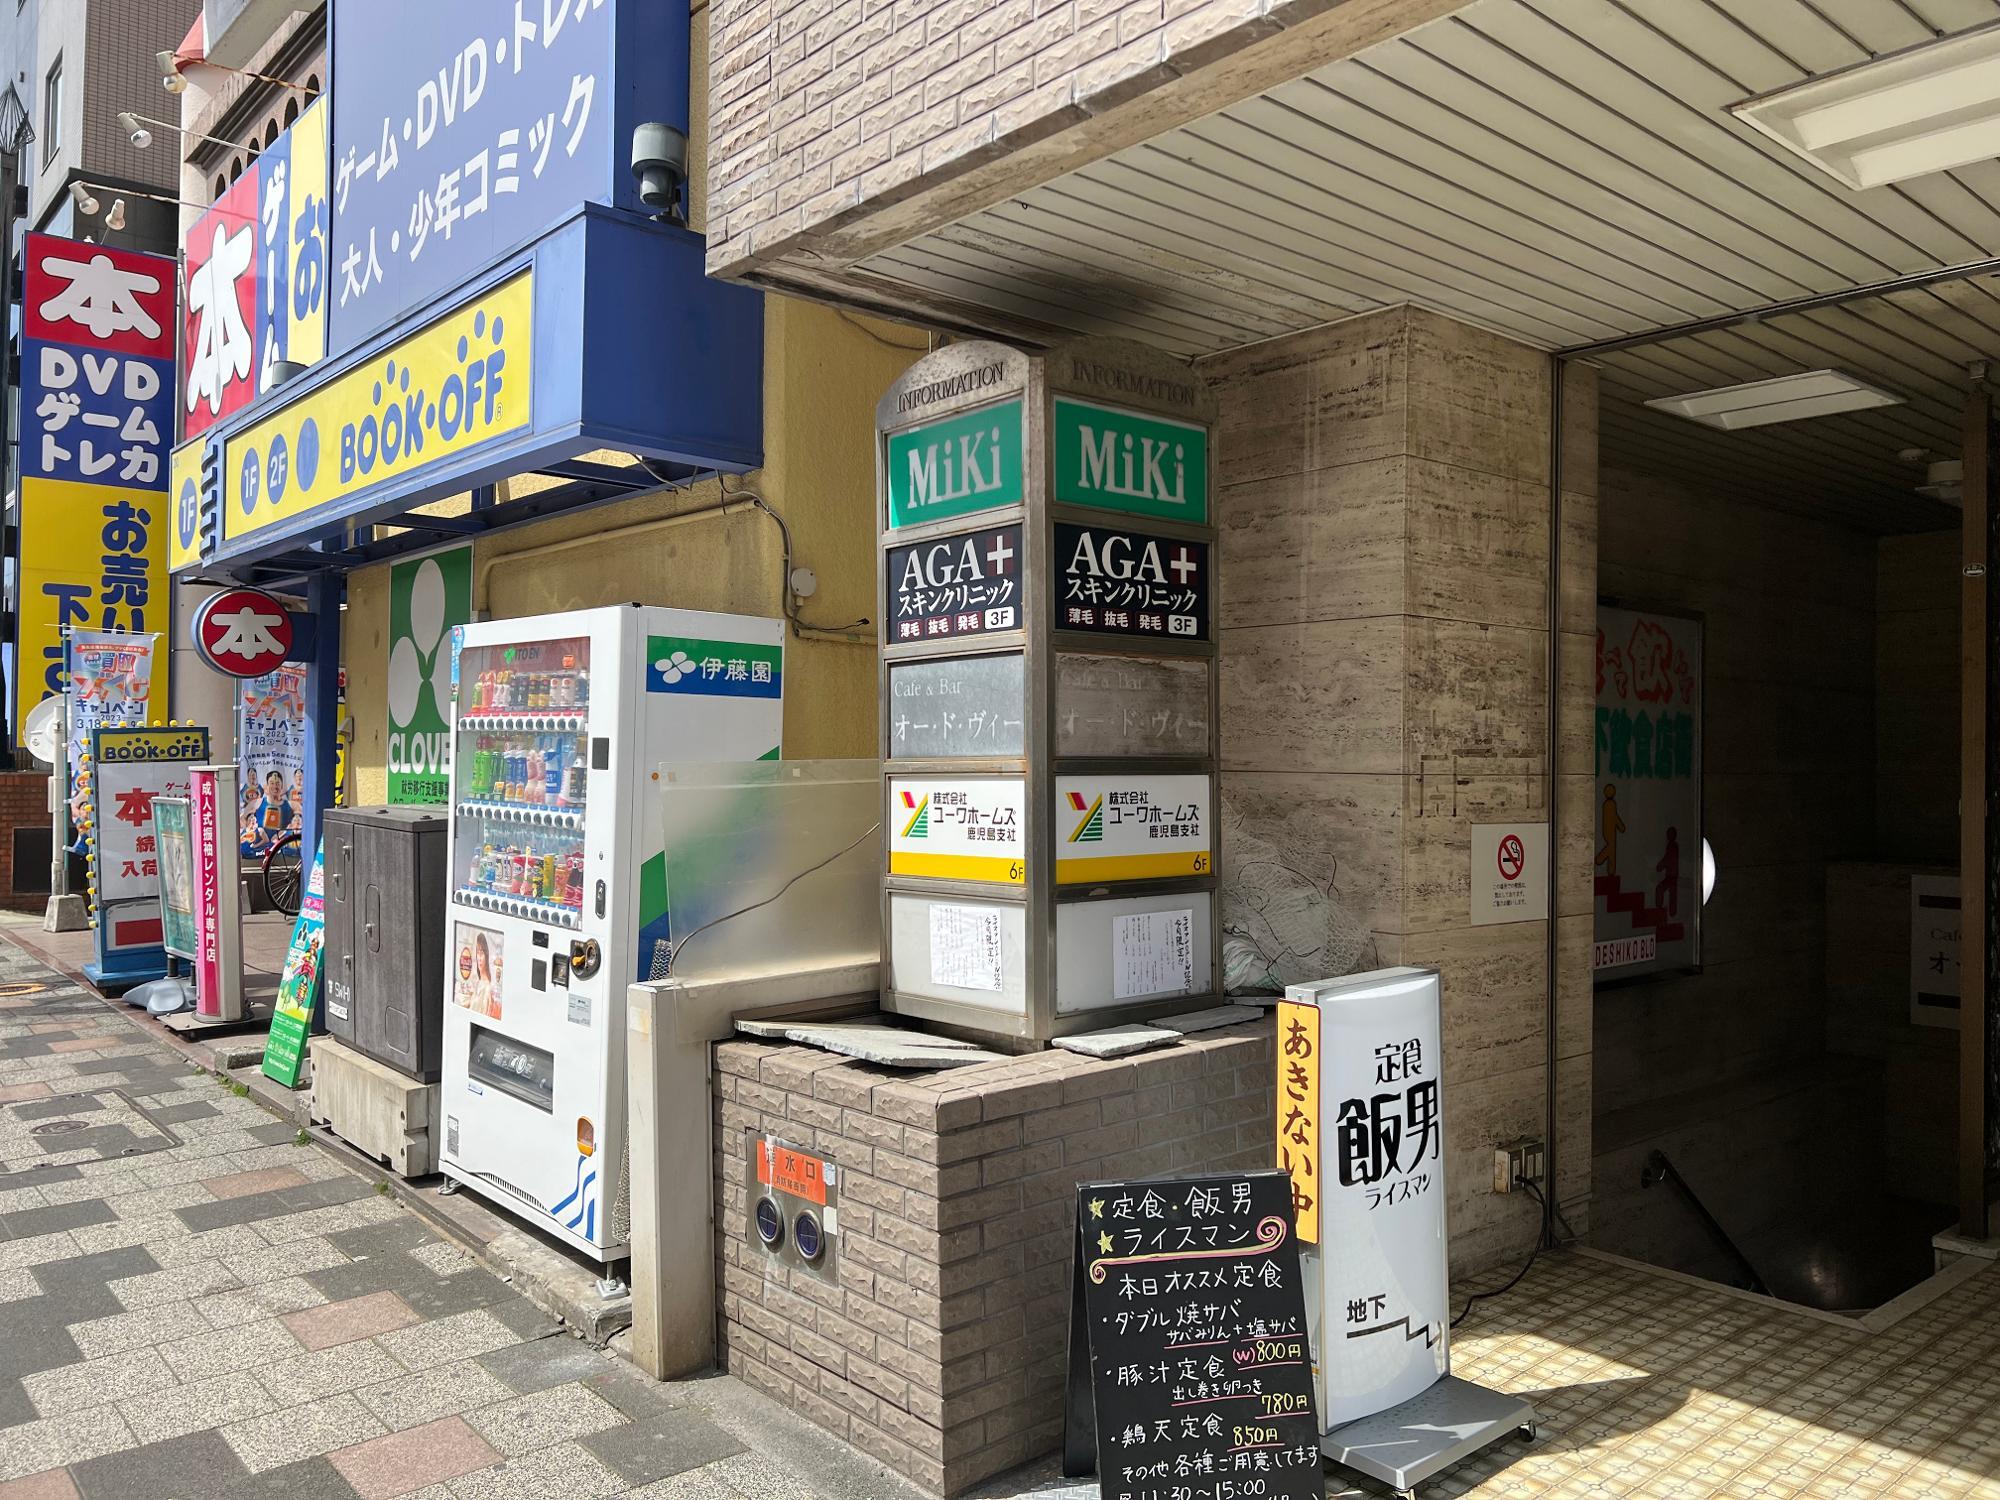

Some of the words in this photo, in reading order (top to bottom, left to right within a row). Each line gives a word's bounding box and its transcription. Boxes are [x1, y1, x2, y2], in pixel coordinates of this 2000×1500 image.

[340, 74, 595, 307] 大人・少年コミック
[39, 254, 162, 339] 本
[187, 223, 253, 416] 本
[40, 346, 161, 401] DVD
[897, 362, 1004, 414] INFORMATION
[1073, 359, 1196, 407] INFORMATION
[36, 392, 161, 446] ゲーム
[42, 433, 159, 483] トレカ
[270, 450, 288, 488] 2F
[243, 463, 258, 498] 1F
[181, 498, 196, 533] 1F
[898, 578, 1014, 617] スキンクリニック
[1065, 578, 1197, 612] スキンクリニック
[211, 606, 286, 660] 本
[900, 622, 920, 638] 薄毛
[928, 617, 948, 634] 抜毛
[957, 611, 979, 629] 発毛
[990, 611, 1009, 629] 3F
[1068, 607, 1094, 625] 薄毛
[1104, 611, 1128, 628] 抜毛
[1139, 614, 1162, 630] 発毛
[1173, 618, 1192, 632] 3F
[700, 655, 772, 683] 伊藤園
[939, 678, 961, 695] Bar
[76, 698, 144, 715] キャンペーン
[115, 788, 160, 827] 本
[933, 792, 967, 805] 株式会社
[1109, 790, 1148, 805] 株式会社
[967, 827, 1016, 841] 鹿児島支社
[1148, 823, 1199, 838] 鹿児島支社
[202, 782, 216, 962] 成人式振袖レンタル専門店
[1009, 863, 1023, 880] 6F
[1193, 854, 1207, 872] 6F
[1375, 1038, 1421, 1085] 定食
[1282, 1018, 1314, 1226] あきない中
[1336, 1077, 1439, 1188] 飯男
[1365, 1174, 1431, 1211] ライスマン
[1123, 1223, 1250, 1255] ライスマン
[1119, 1259, 1283, 1300] 本日オススメ定食
[1347, 1294, 1386, 1323] 地下
[1172, 1379, 1263, 1401] 出し巻き卵つき
[1261, 1393, 1308, 1414] 780円
[1233, 1426, 1278, 1445] 850円
[1122, 1444, 1319, 1484] その他各種ご用意してます
